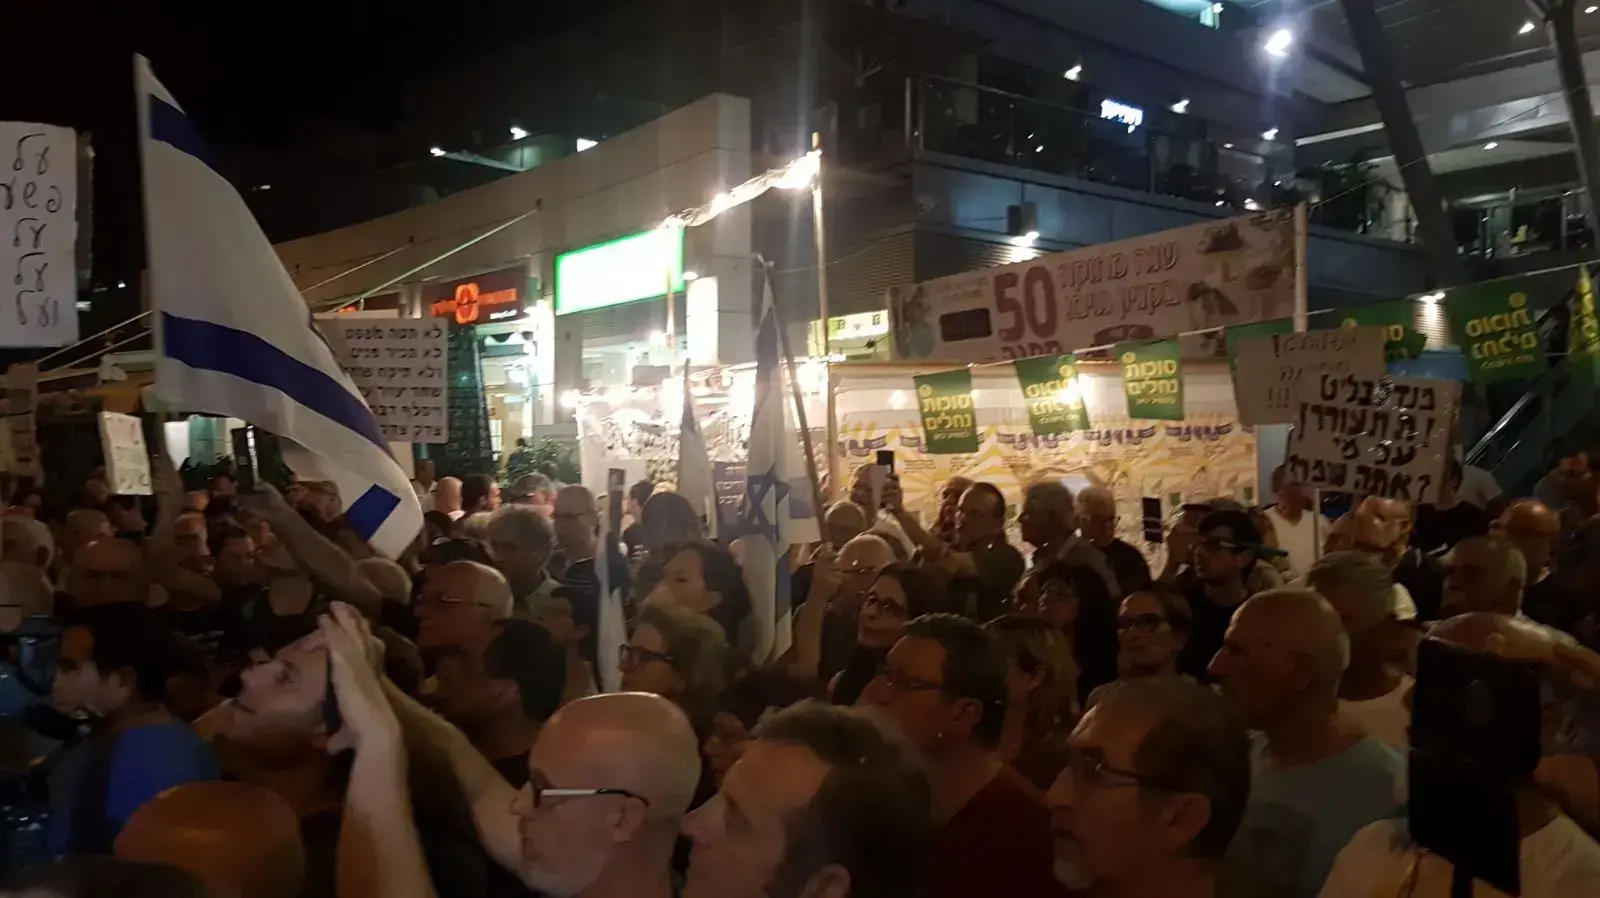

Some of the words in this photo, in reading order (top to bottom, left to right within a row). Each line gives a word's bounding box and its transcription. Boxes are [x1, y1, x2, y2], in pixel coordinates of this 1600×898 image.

[994, 265, 1058, 342] 50
[1124, 360, 1177, 380] סוכות
[1126, 377, 1179, 395] נחלים
[922, 394, 970, 412] סוכות
[925, 412, 972, 430] נחלים
